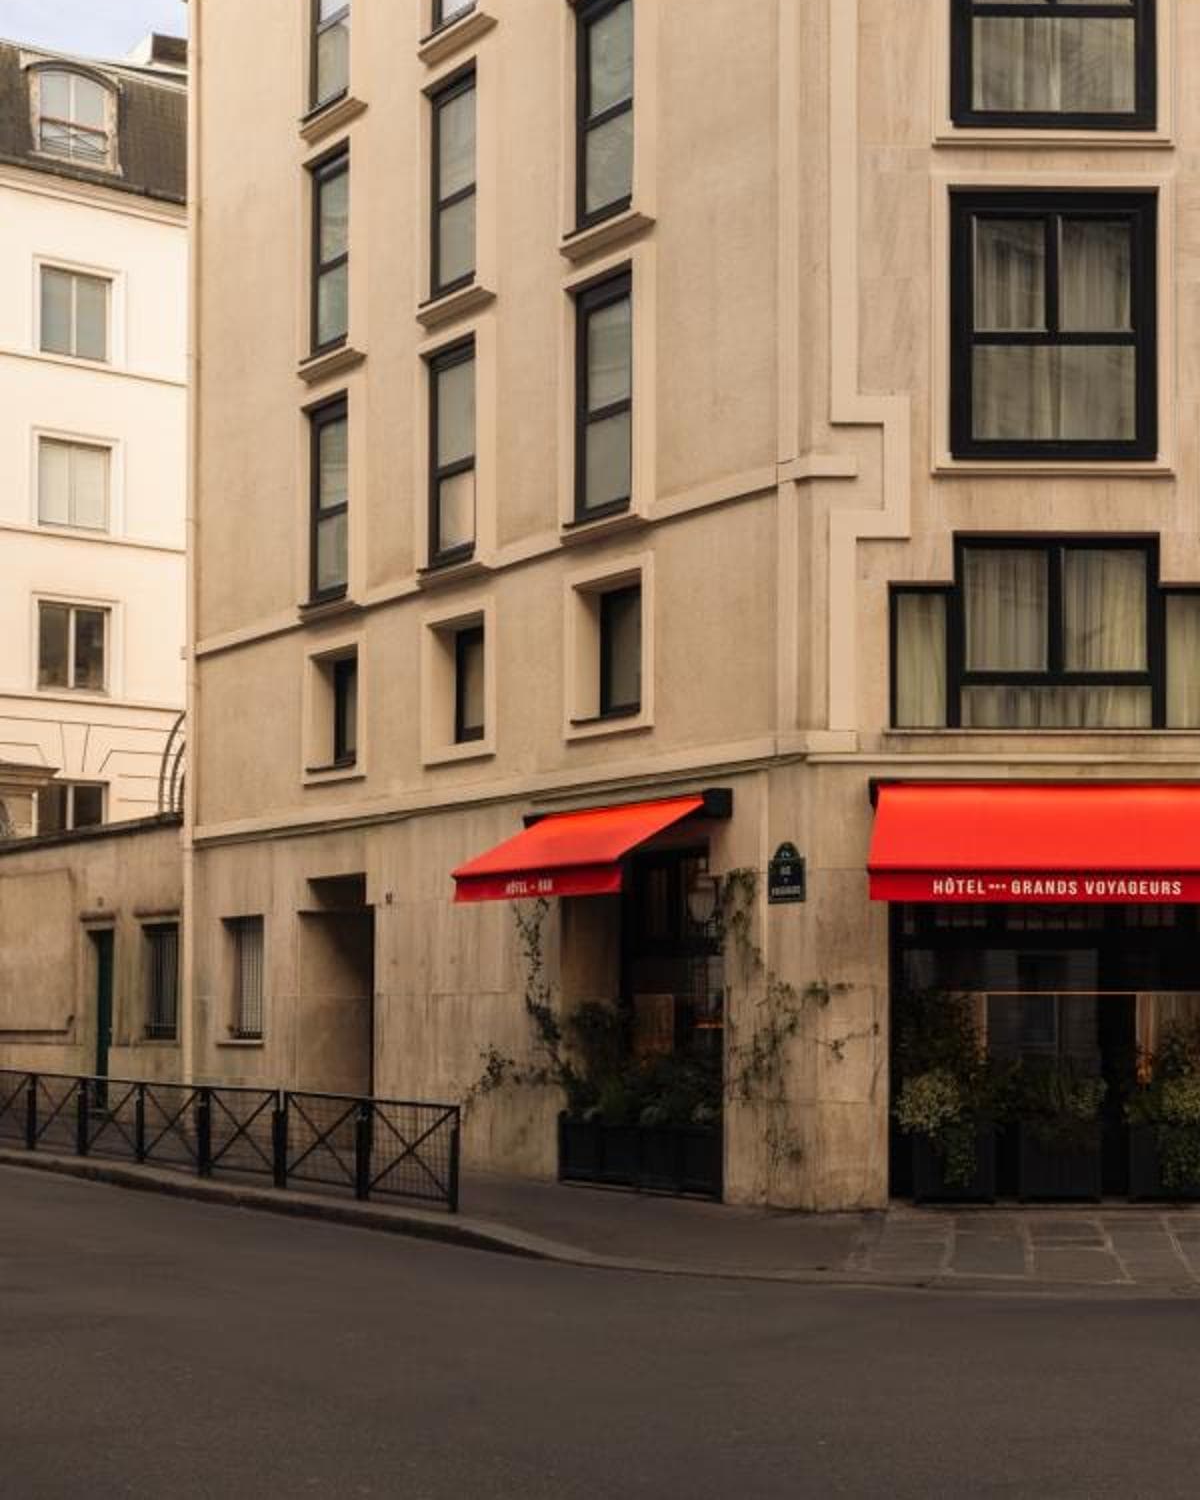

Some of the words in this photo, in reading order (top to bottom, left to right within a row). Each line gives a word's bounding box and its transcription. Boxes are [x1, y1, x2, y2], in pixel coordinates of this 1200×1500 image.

[933, 877, 986, 895] HÔTEL
[1011, 879, 1078, 895] GRANDS
[1085, 879, 1182, 895] VOYAGEURS
